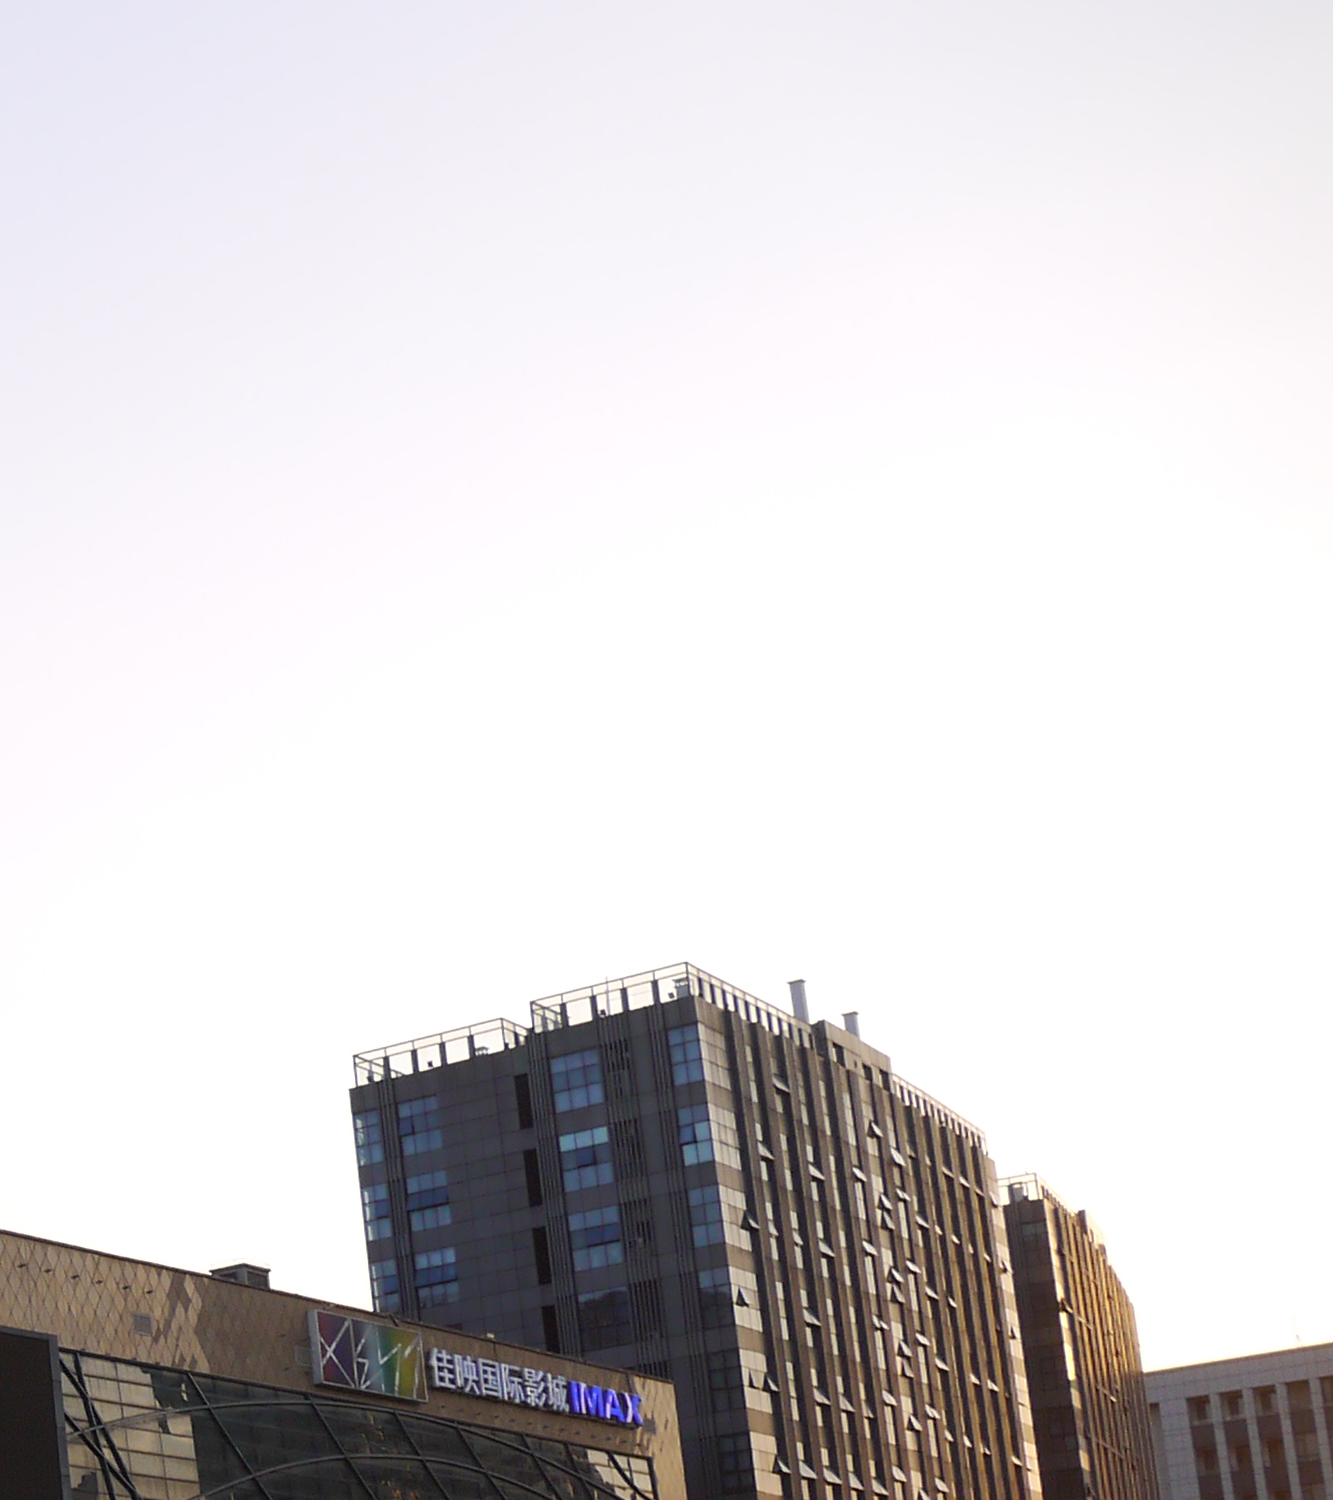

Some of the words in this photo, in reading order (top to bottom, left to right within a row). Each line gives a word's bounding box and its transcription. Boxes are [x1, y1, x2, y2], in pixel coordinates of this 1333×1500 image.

[427, 1346, 571, 1413] 佳映国际影城
[569, 1380, 645, 1427] IMAX
